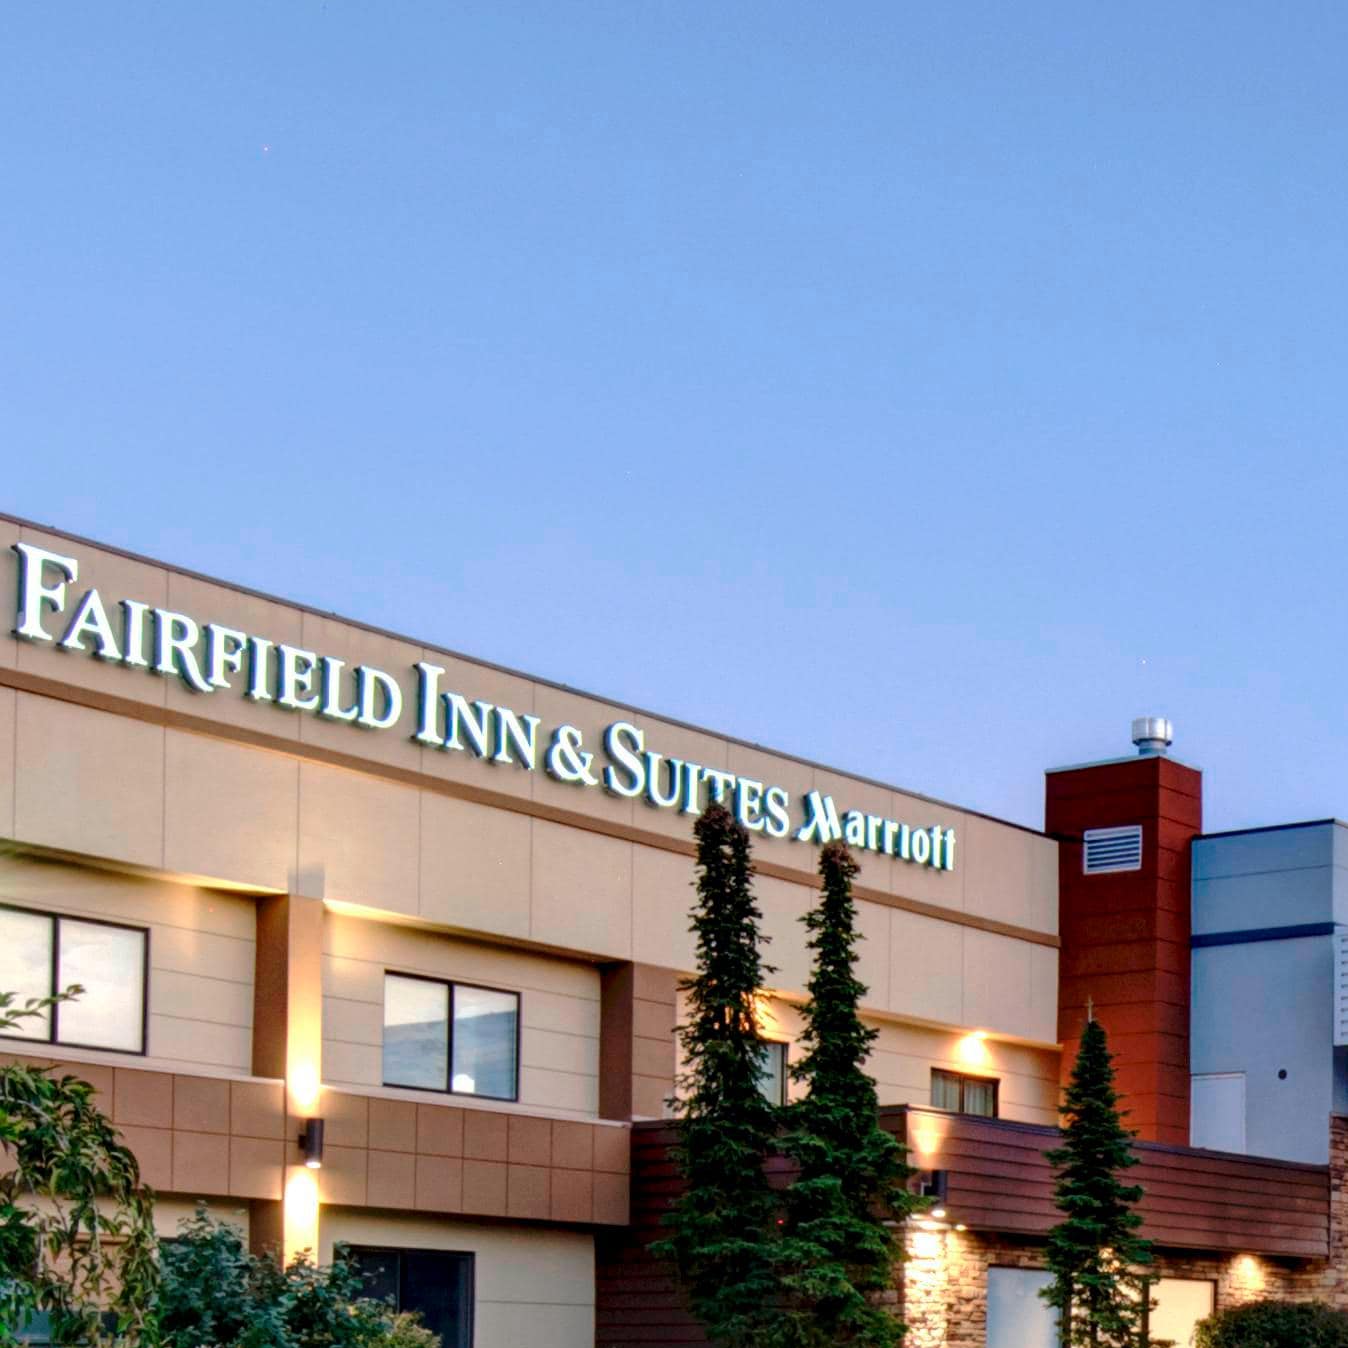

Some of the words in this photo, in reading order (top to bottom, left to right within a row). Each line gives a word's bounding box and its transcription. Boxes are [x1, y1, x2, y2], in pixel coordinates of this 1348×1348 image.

[13, 541, 403, 731] FAIRFIELD
[413, 661, 540, 771] INN
[546, 723, 599, 787] &
[603, 720, 790, 838] SUITES
[795, 789, 956, 871] Marriott
